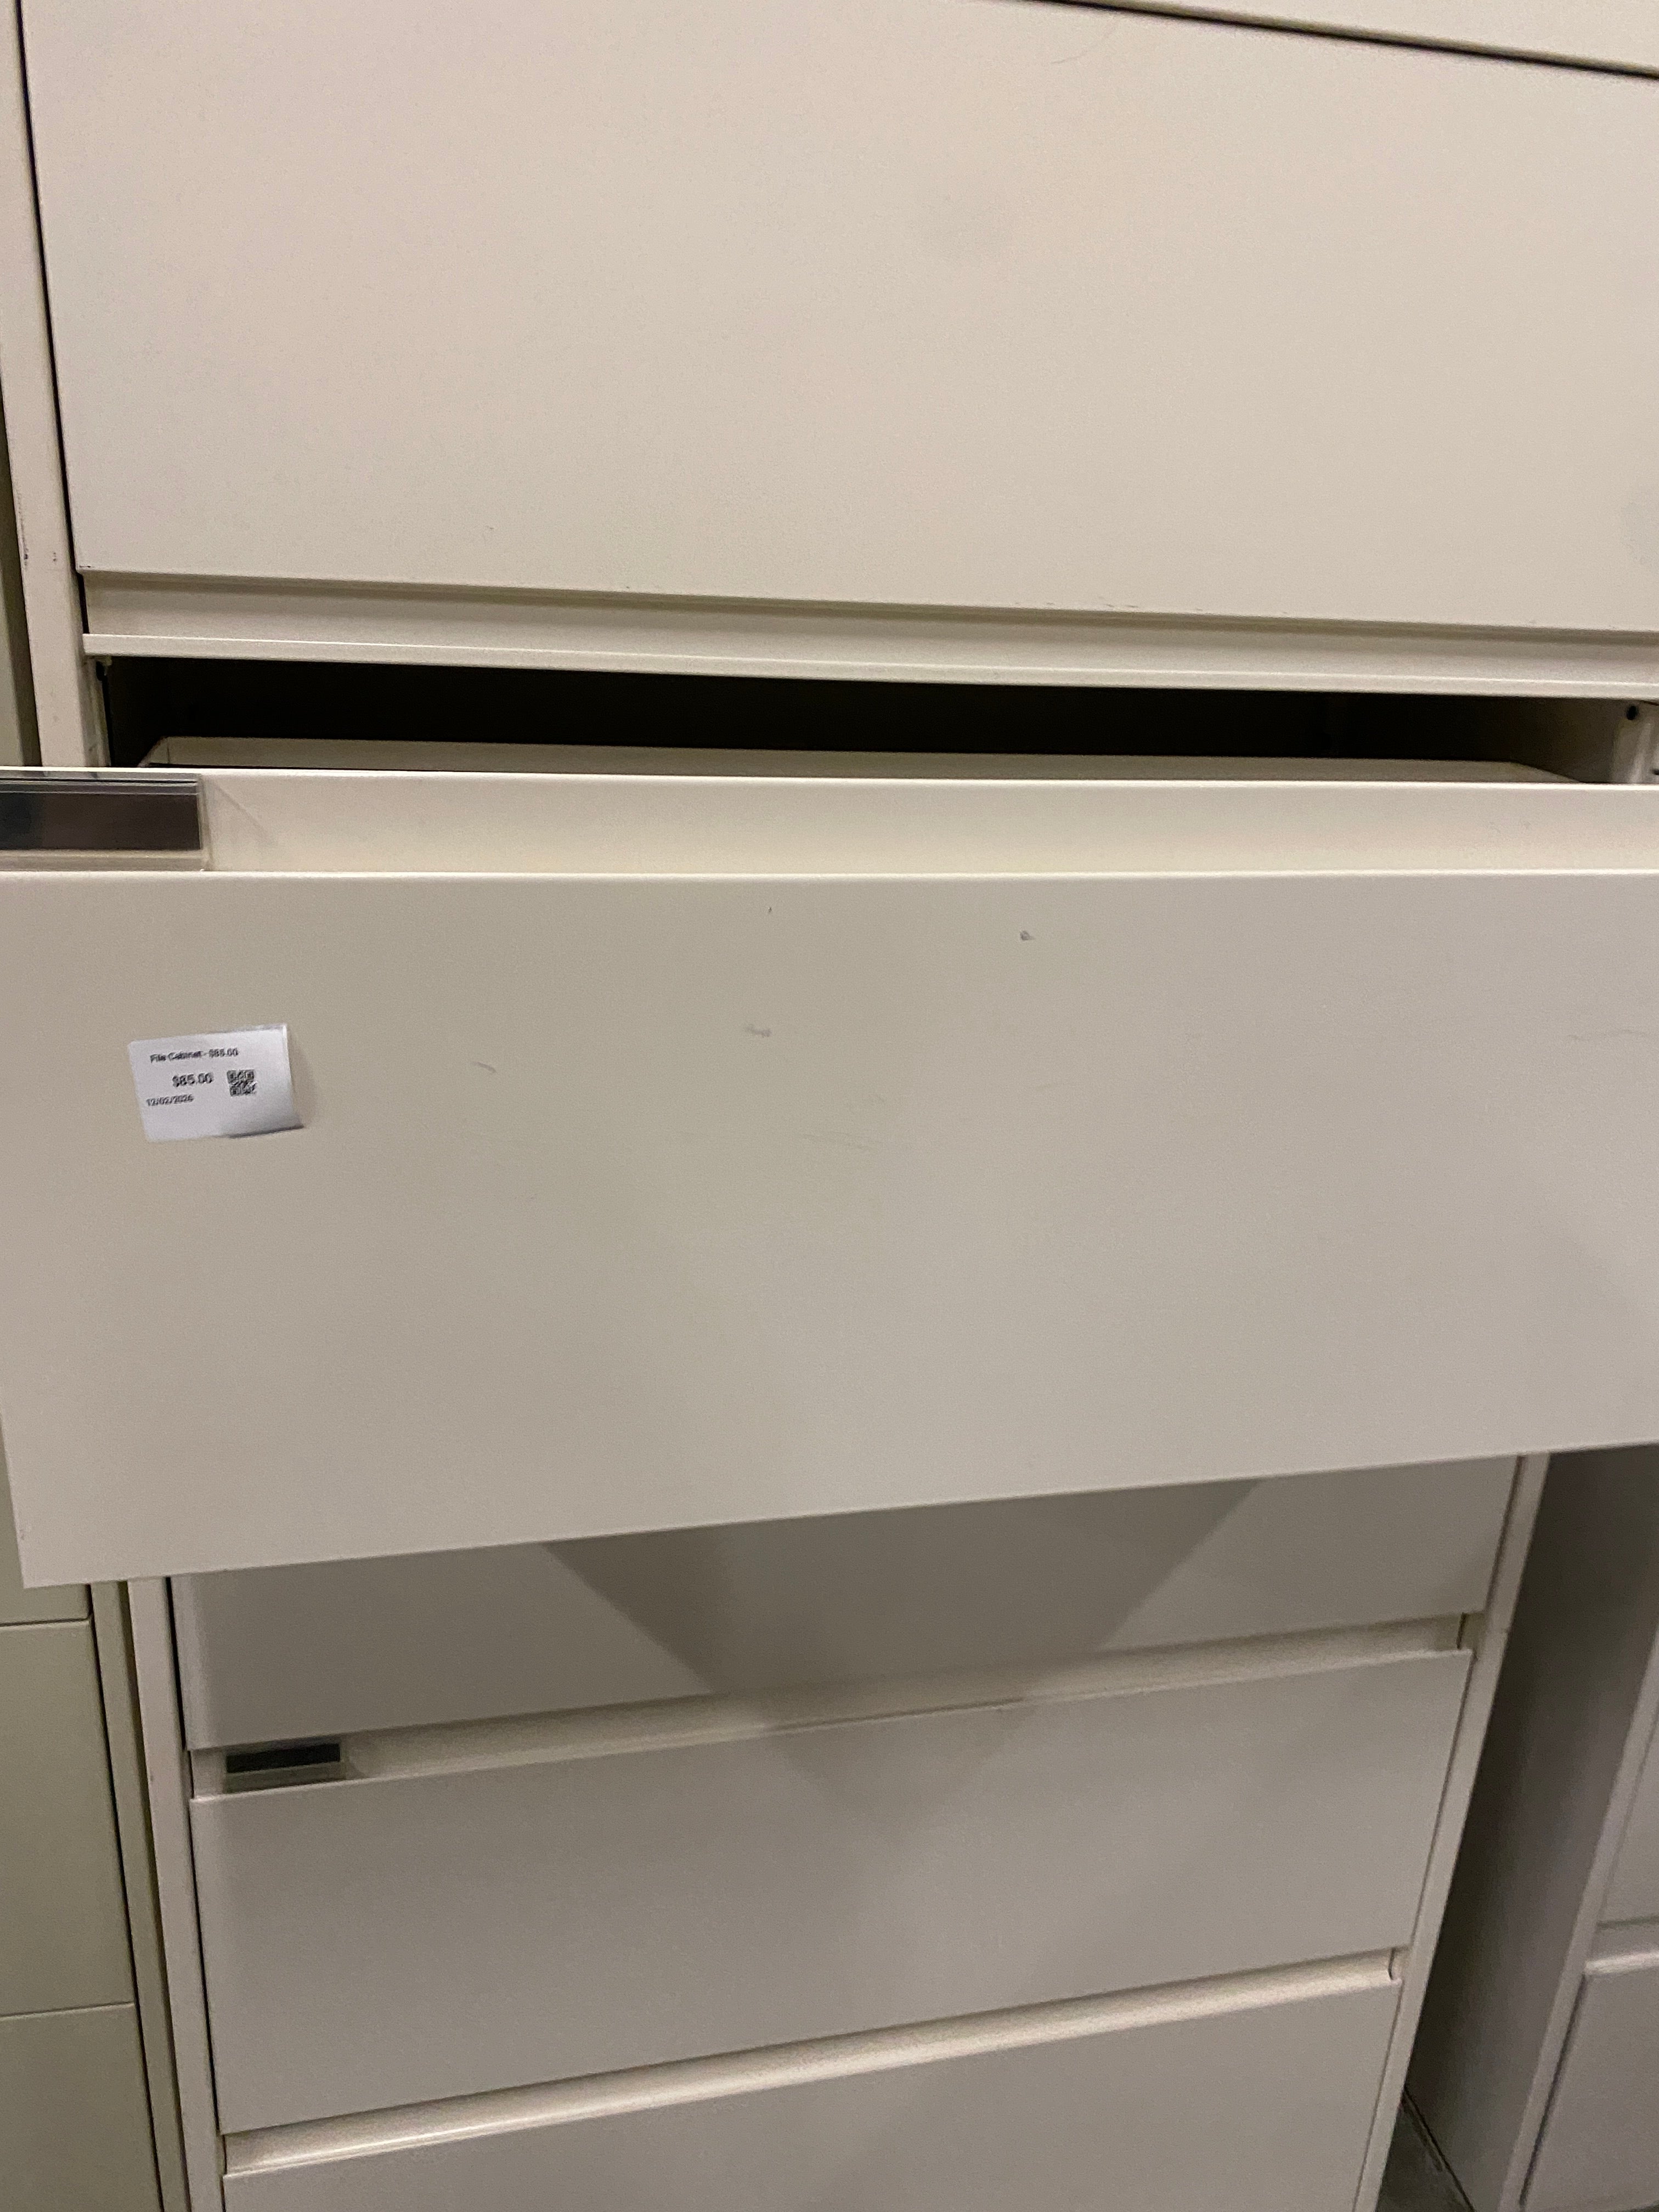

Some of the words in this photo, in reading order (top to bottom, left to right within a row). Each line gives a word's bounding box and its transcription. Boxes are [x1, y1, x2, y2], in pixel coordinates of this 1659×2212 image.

[150, 1053, 166, 1063] File
[168, 1051, 203, 1061] Cabinet
[172, 1073, 213, 1087] $85.00
